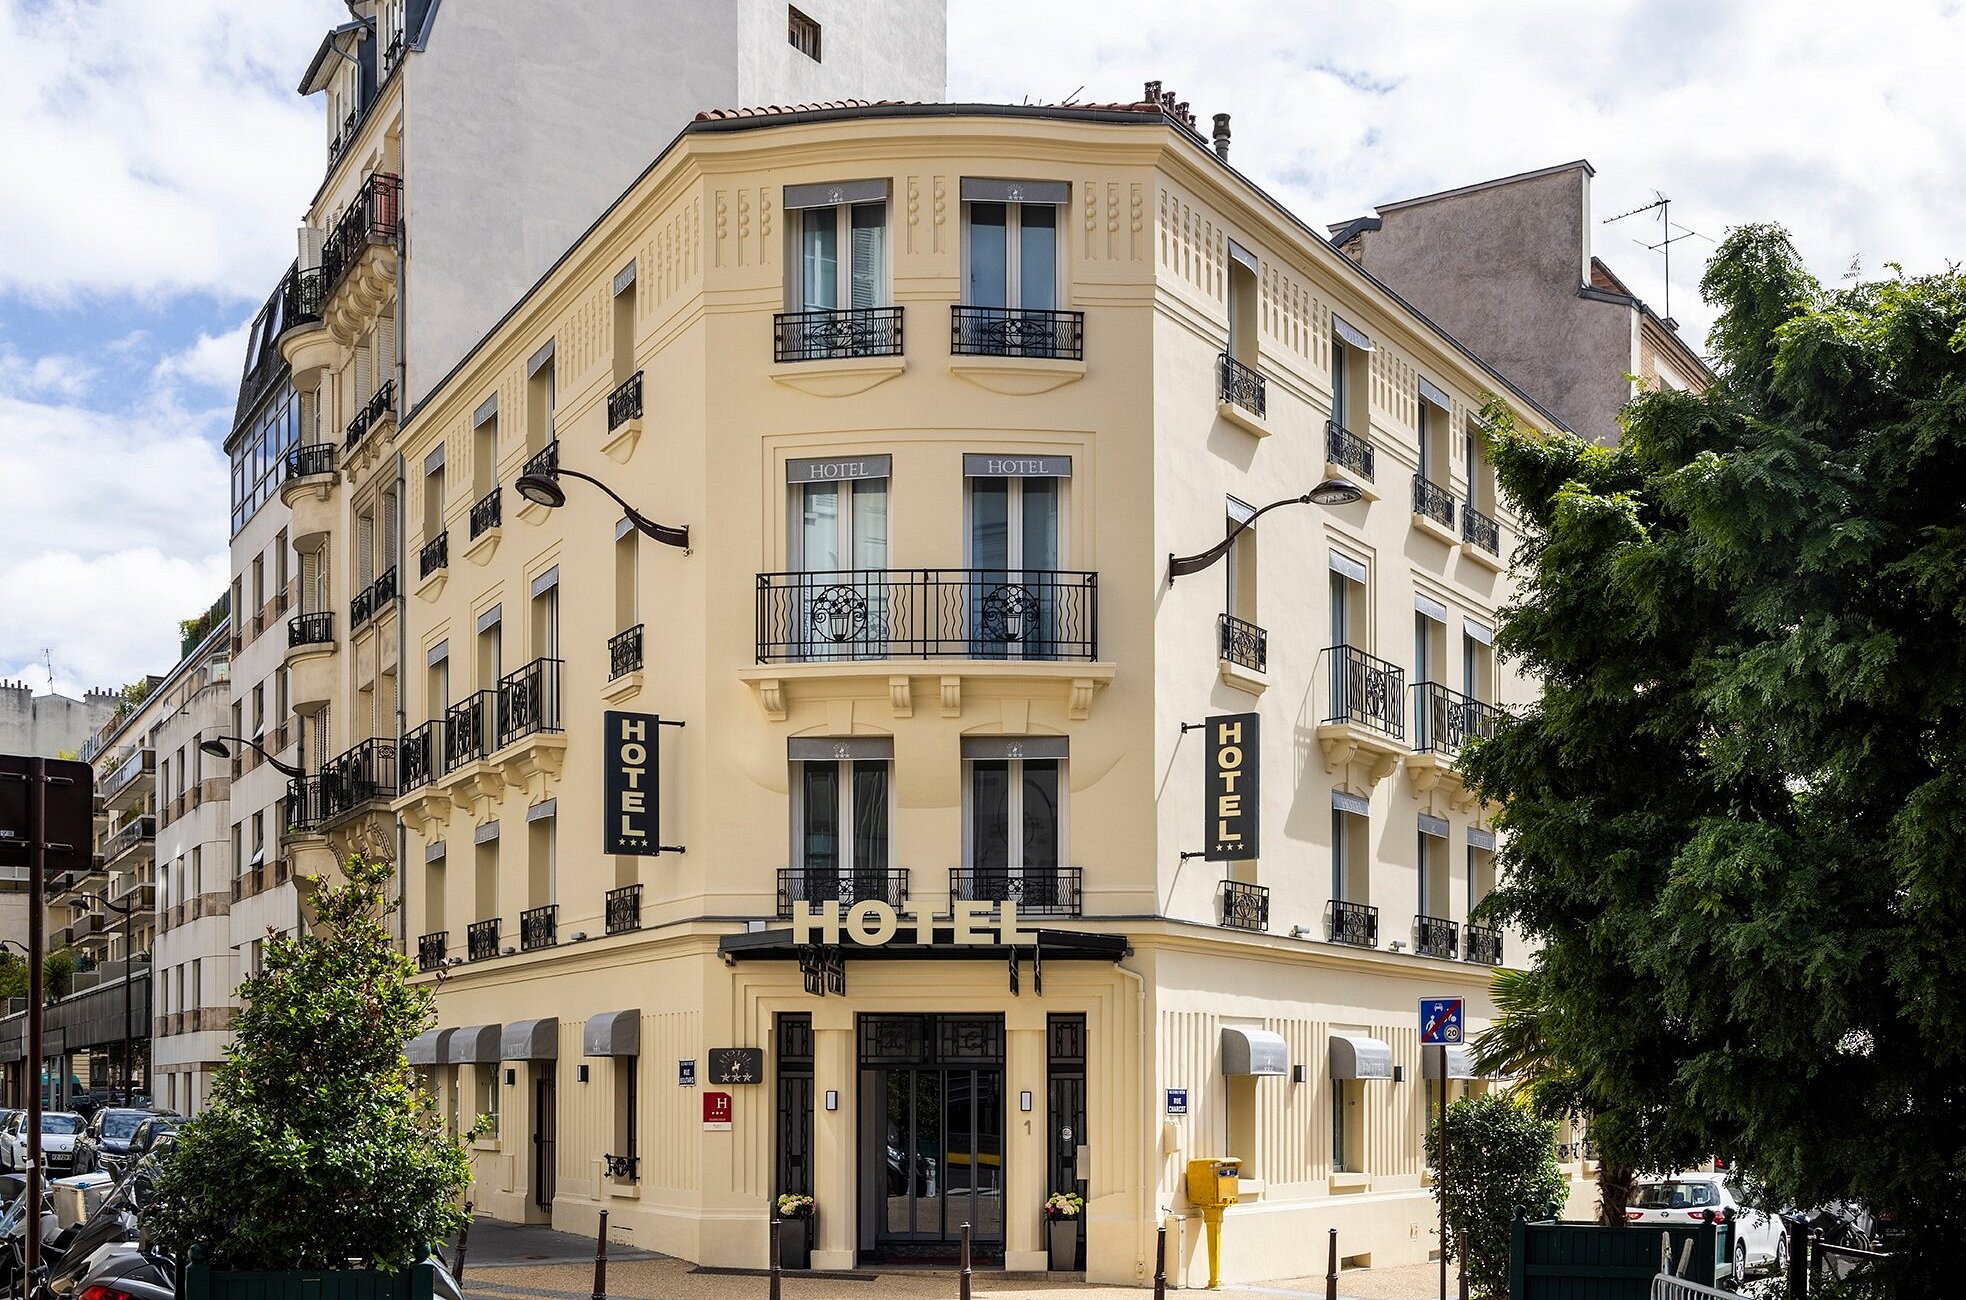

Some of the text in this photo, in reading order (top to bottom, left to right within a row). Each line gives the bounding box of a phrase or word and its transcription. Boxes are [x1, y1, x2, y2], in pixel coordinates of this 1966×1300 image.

[809, 462, 869, 479] HOTEL
[988, 460, 1049, 474] HOTEL
[620, 719, 647, 837] HOTEL
[1217, 721, 1243, 842] HOTEL
[793, 899, 1038, 946] HOTEL
[1447, 1029, 1457, 1037] 20
[507, 1042, 526, 1057] HOTEL
[717, 1097, 728, 1109] H
[1168, 1105, 1186, 1113] CHARCOT
[1024, 1120, 1031, 1135] 1
